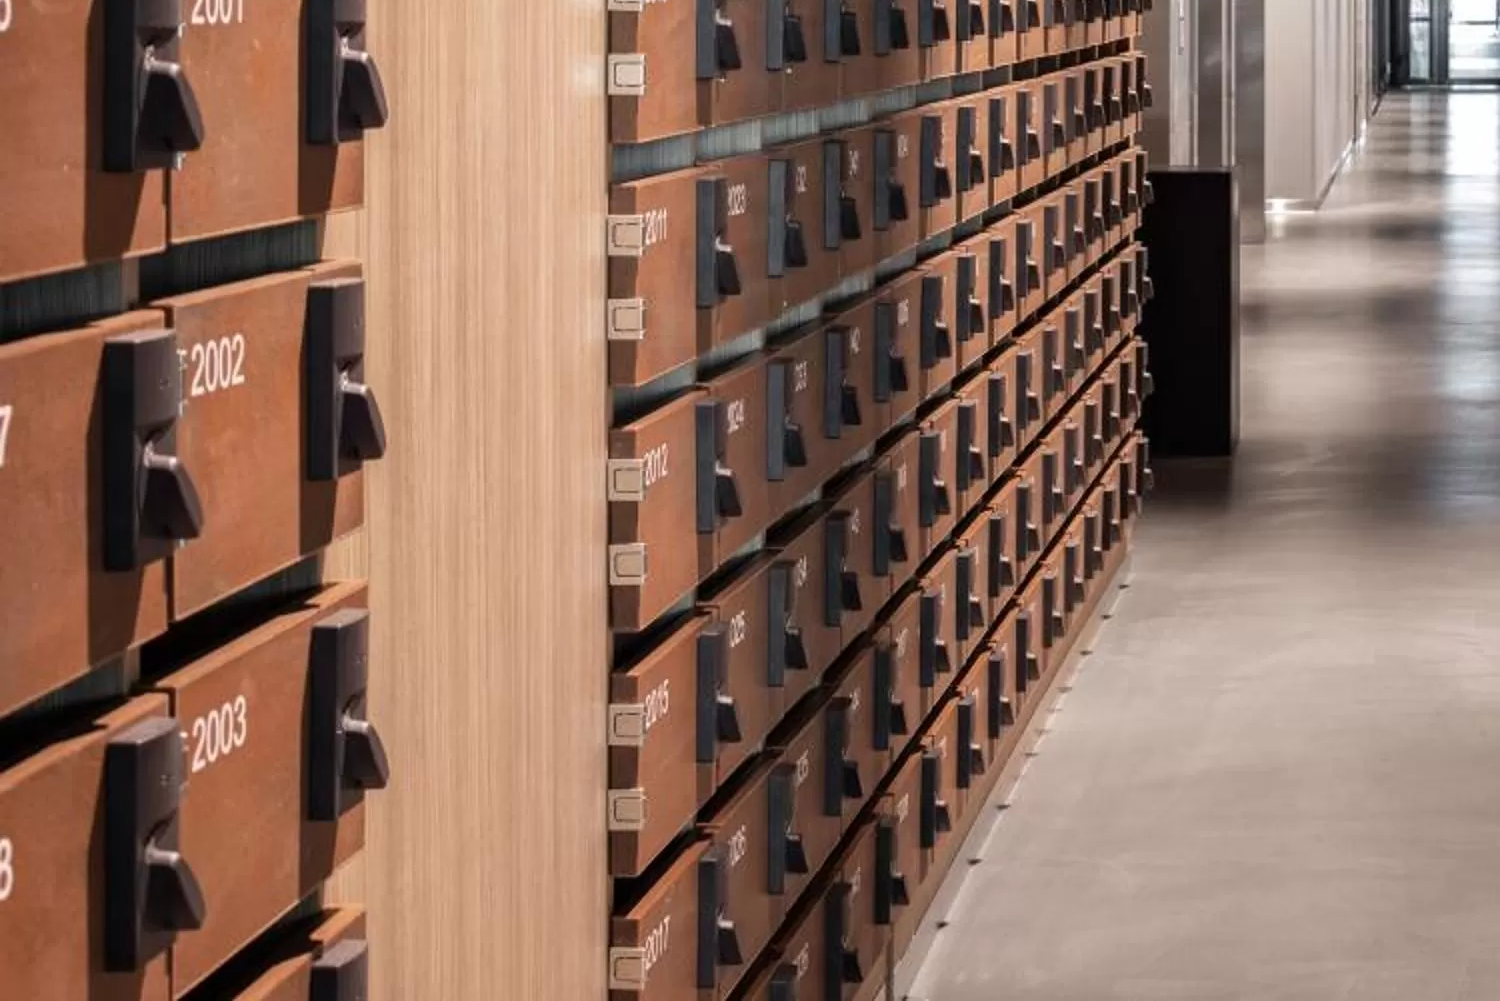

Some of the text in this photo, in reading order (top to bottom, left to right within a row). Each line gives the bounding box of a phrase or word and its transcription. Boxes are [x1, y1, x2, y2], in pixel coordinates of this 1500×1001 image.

[645, 208, 668, 246] 2011
[191, 333, 244, 397] 2002
[645, 443, 669, 487] 2012
[192, 694, 246, 773] 2003
[645, 914, 671, 970] 2017
